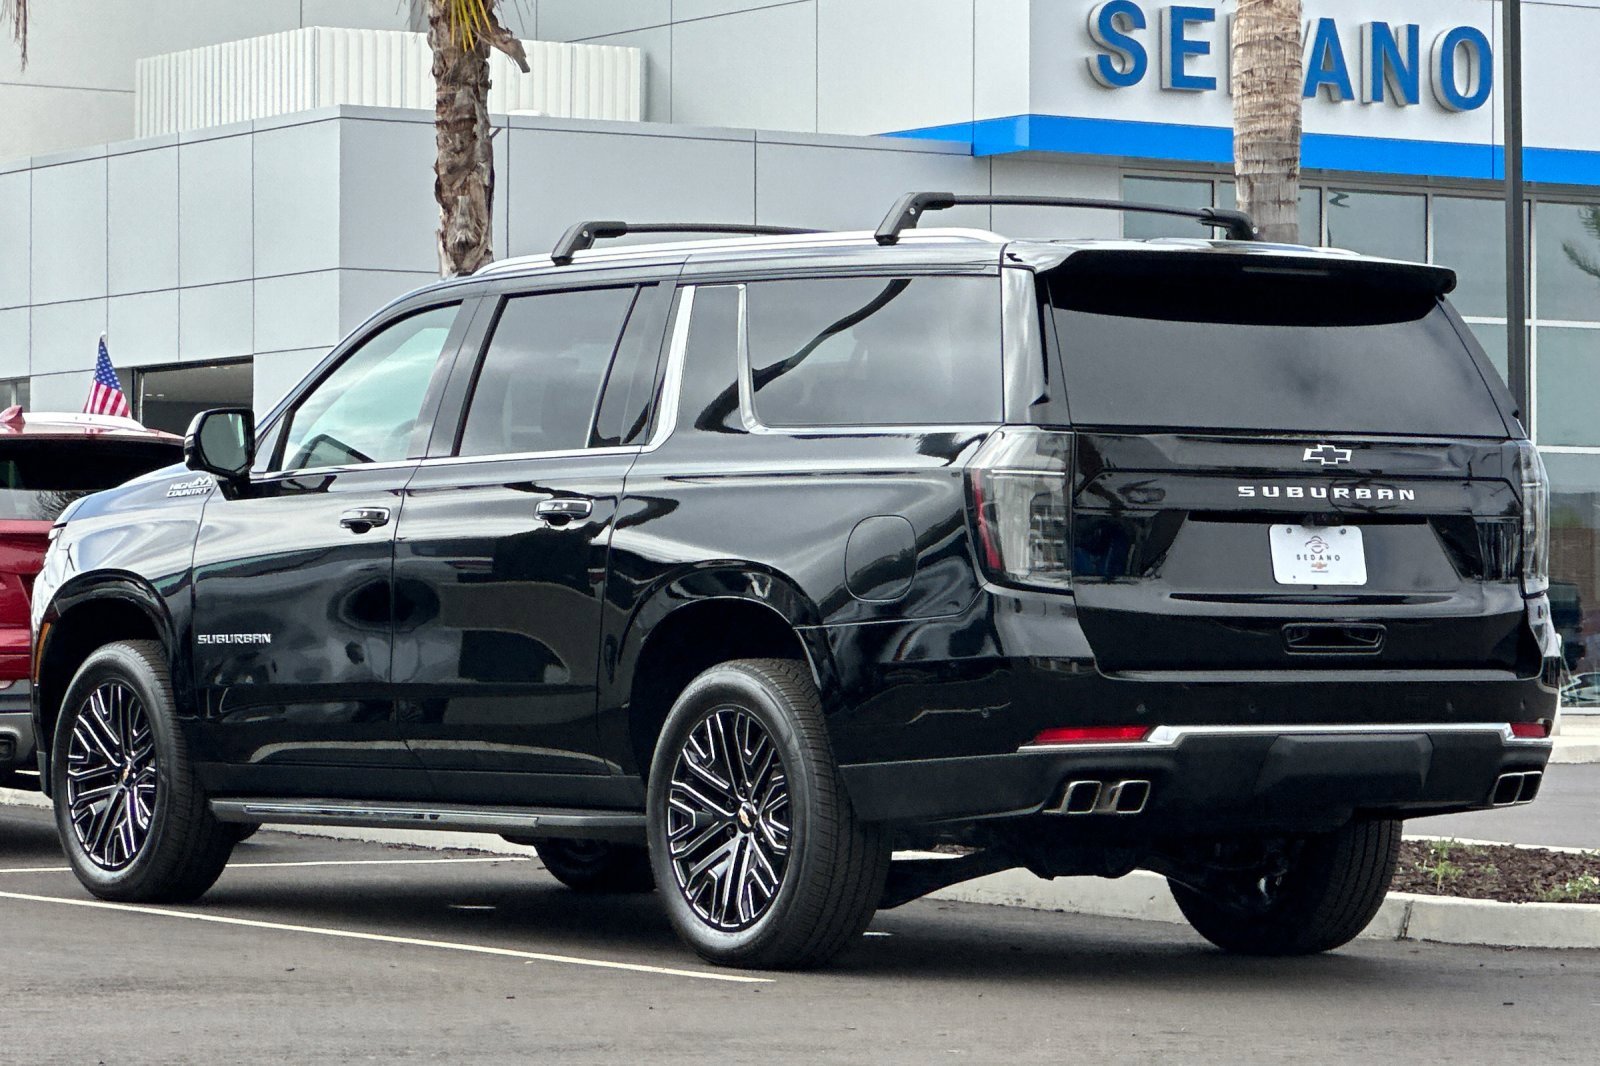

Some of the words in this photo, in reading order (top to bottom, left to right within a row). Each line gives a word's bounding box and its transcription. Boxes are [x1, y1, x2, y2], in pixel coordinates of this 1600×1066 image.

[1089, 0, 1492, 112] SEANO
[170, 482, 195, 490] HIGH
[167, 487, 211, 497] COUNTRY
[1238, 486, 1416, 500] SUBURBAN
[197, 633, 272, 644] SUBURBAN
